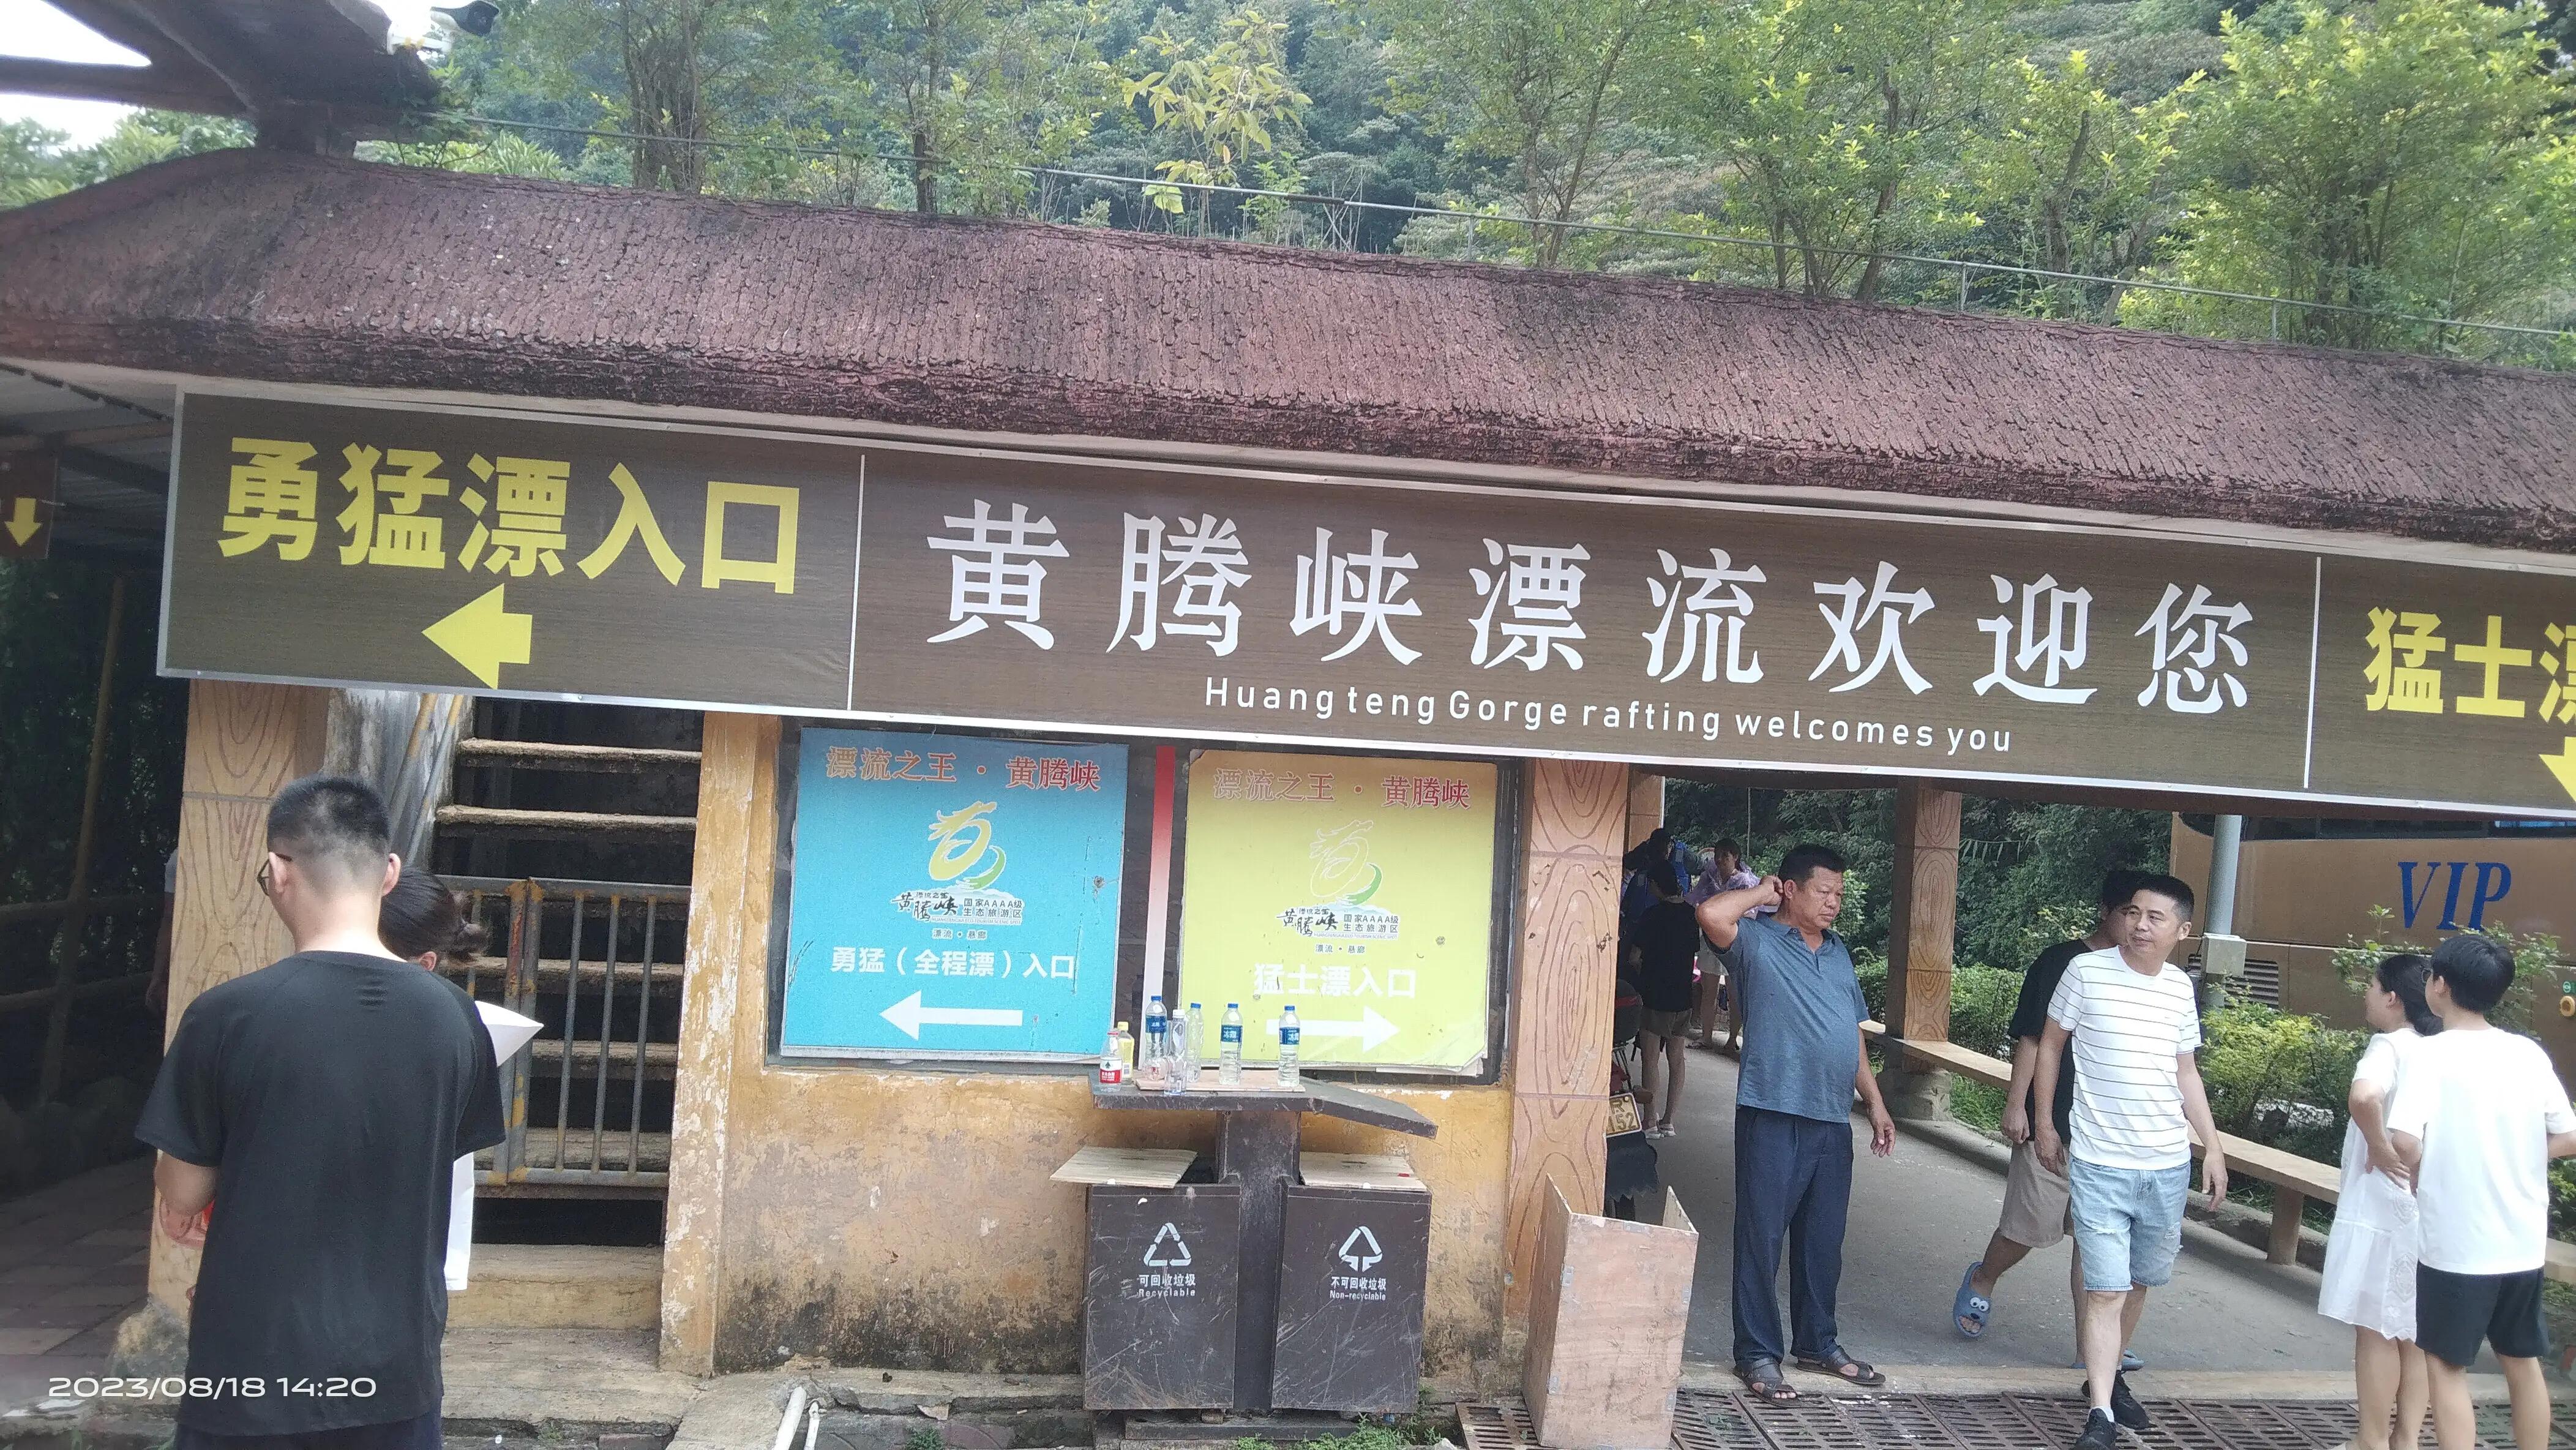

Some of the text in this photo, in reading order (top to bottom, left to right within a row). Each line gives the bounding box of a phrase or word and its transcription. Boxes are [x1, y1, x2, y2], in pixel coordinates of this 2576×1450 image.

[218, 437, 799, 594] 勇猛漂入口
[926, 499, 2253, 714] 黄腾峡漂流欢迎您
[1205, 676, 2010, 756] Huang teng Gorge rafting welcomes you
[2397, 862, 2512, 931] VIP
[964, 907, 1022, 918] 生态旅游区
[1344, 923, 1398, 933] 生态旅游区
[1254, 963, 1416, 999] 猛士漂入口
[1138, 1274, 1196, 1288] 可回收垃圾
[1330, 1276, 1387, 1291] 不可回收垃圾
[1139, 1288, 1196, 1299] Recyclable
[1330, 1290, 1386, 1302] Non-recyclable
